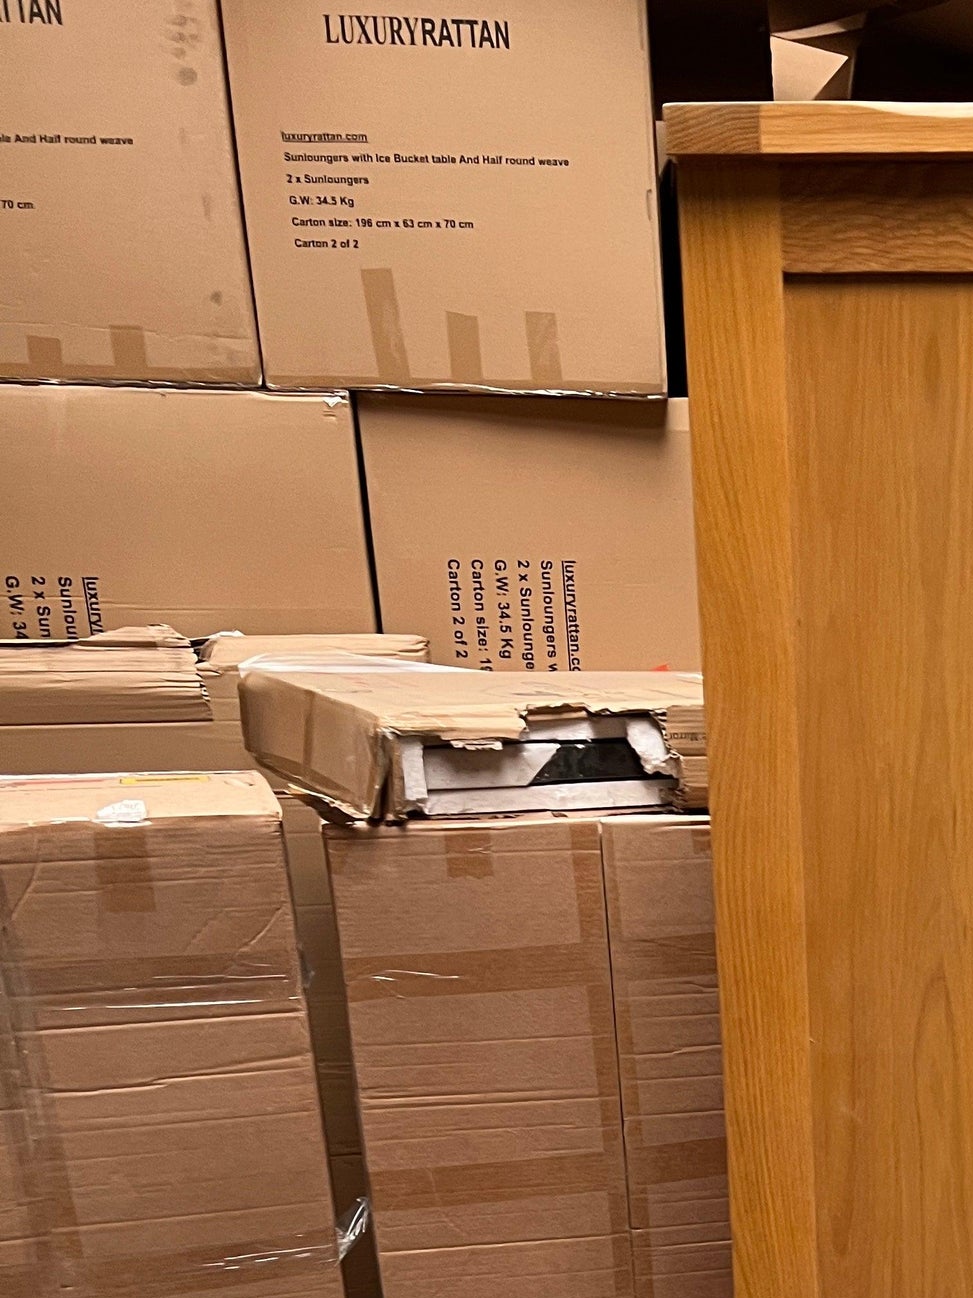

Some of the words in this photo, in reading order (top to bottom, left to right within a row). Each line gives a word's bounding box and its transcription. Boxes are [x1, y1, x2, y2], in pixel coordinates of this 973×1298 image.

[0, 0, 63, 25] TTAN
[323, 14, 511, 50] LUXURYRATTAN
[64, 135, 97, 145] round
[99, 137, 134, 146] weave
[280, 131, 368, 143] luxuryrattan.com
[284, 152, 349, 165] Sunloungers
[351, 153, 374, 163] with
[375, 153, 391, 163] Ice
[393, 153, 429, 164] Bucket
[431, 155, 457, 164] table
[459, 155, 480, 164] And
[482, 155, 503, 165] Half
[505, 157, 536, 166] round
[537, 159, 570, 167] weave
[286, 173, 293, 184] 2
[303, 173, 370, 187] Sunloungers
[316, 195, 337, 206] 34.5
[340, 196, 355, 208] Kg
[291, 216, 326, 227] Carton
[328, 217, 353, 227] size:
[355, 218, 373, 228] 196
[375, 220, 392, 228] cm
[394, 220, 401, 228] x
[402, 218, 415, 228] 63
[417, 220, 433, 229] cm
[435, 220, 442, 229] x
[443, 219, 456, 229] 70
[458, 220, 475, 229] cm
[294, 238, 329, 248] Carton
[331, 239, 338, 248] 2
[340, 239, 350, 249] of
[352, 239, 360, 249] 2
[518, 560, 530, 569] 2
[31, 576, 46, 586] 2
[518, 573, 529, 582] x
[447, 559, 462, 612] Carton
[471, 559, 486, 612] Carton
[33, 590, 46, 600] x
[540, 560, 557, 658] Sunloungers
[452, 616, 466, 626] 2
[498, 602, 512, 634] 34.5
[475, 616, 490, 652] size:
[519, 587, 535, 670] Sunlounge
[454, 630, 468, 647] of
[455, 650, 469, 659] 2
[498, 638, 514, 659] Kg
